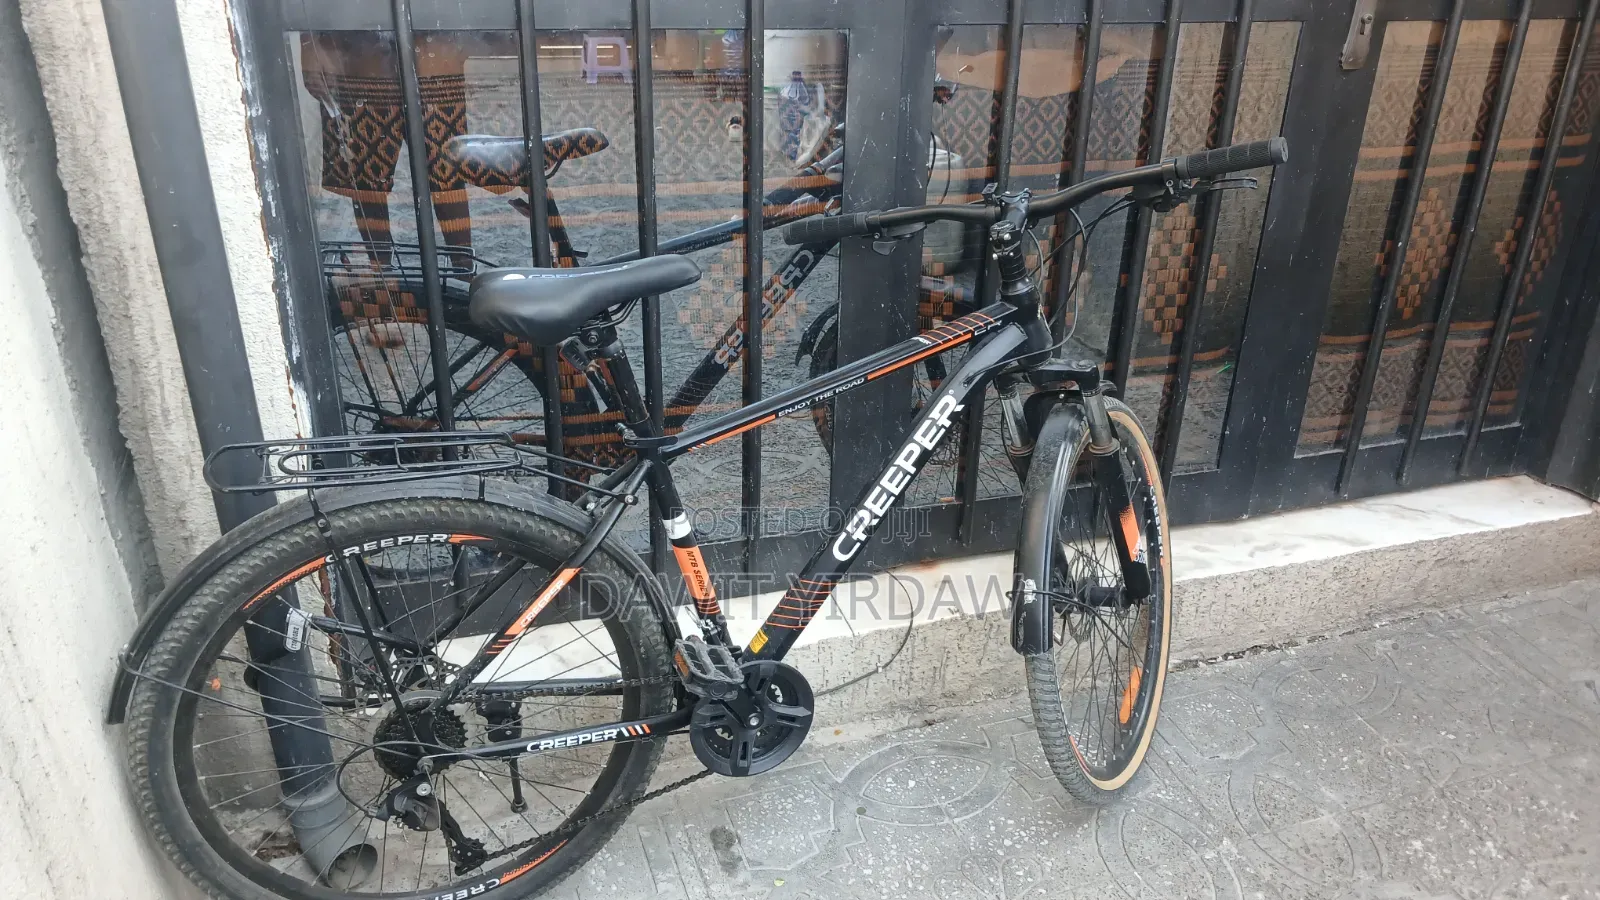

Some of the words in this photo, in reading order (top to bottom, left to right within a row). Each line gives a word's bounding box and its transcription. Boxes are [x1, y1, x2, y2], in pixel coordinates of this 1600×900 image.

[778, 398, 813, 417] ENJOY
[815, 390, 834, 402] THE
[835, 377, 865, 394] ROAD
[832, 392, 965, 562] CREEPER
[325, 533, 450, 563] CREEPER
[686, 550, 699, 568] MTB
[693, 568, 710, 597] SERIES
[526, 727, 620, 752] CREEPER
